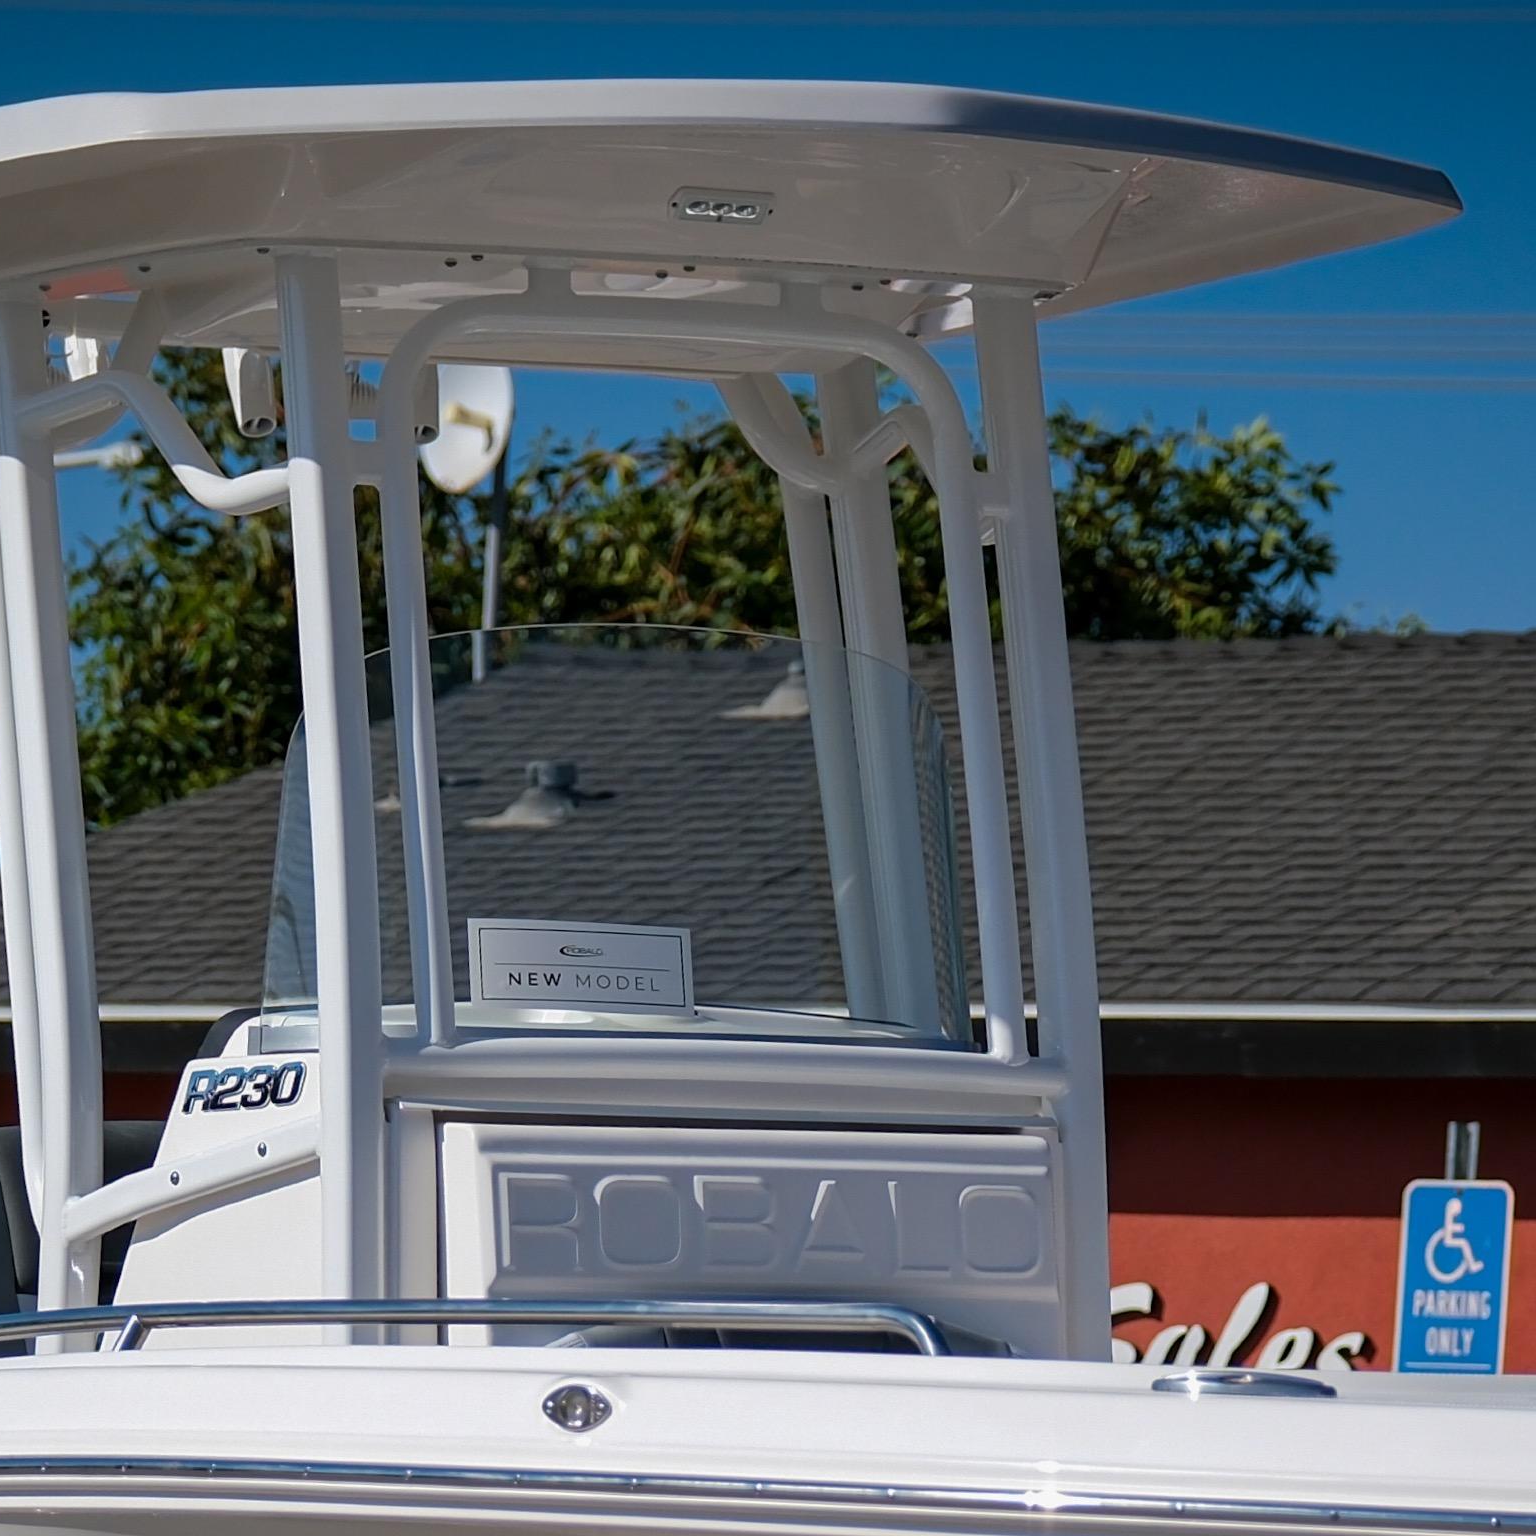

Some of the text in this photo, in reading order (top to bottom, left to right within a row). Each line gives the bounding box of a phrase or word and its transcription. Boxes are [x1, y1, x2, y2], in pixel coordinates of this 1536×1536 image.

[508, 972, 660, 992] NEW MODEL
[182, 1061, 307, 1115] R230
[499, 1171, 1042, 1276] ROBALO
[1412, 1289, 1491, 1320] PARKING
[1425, 1327, 1474, 1356] ONLY
